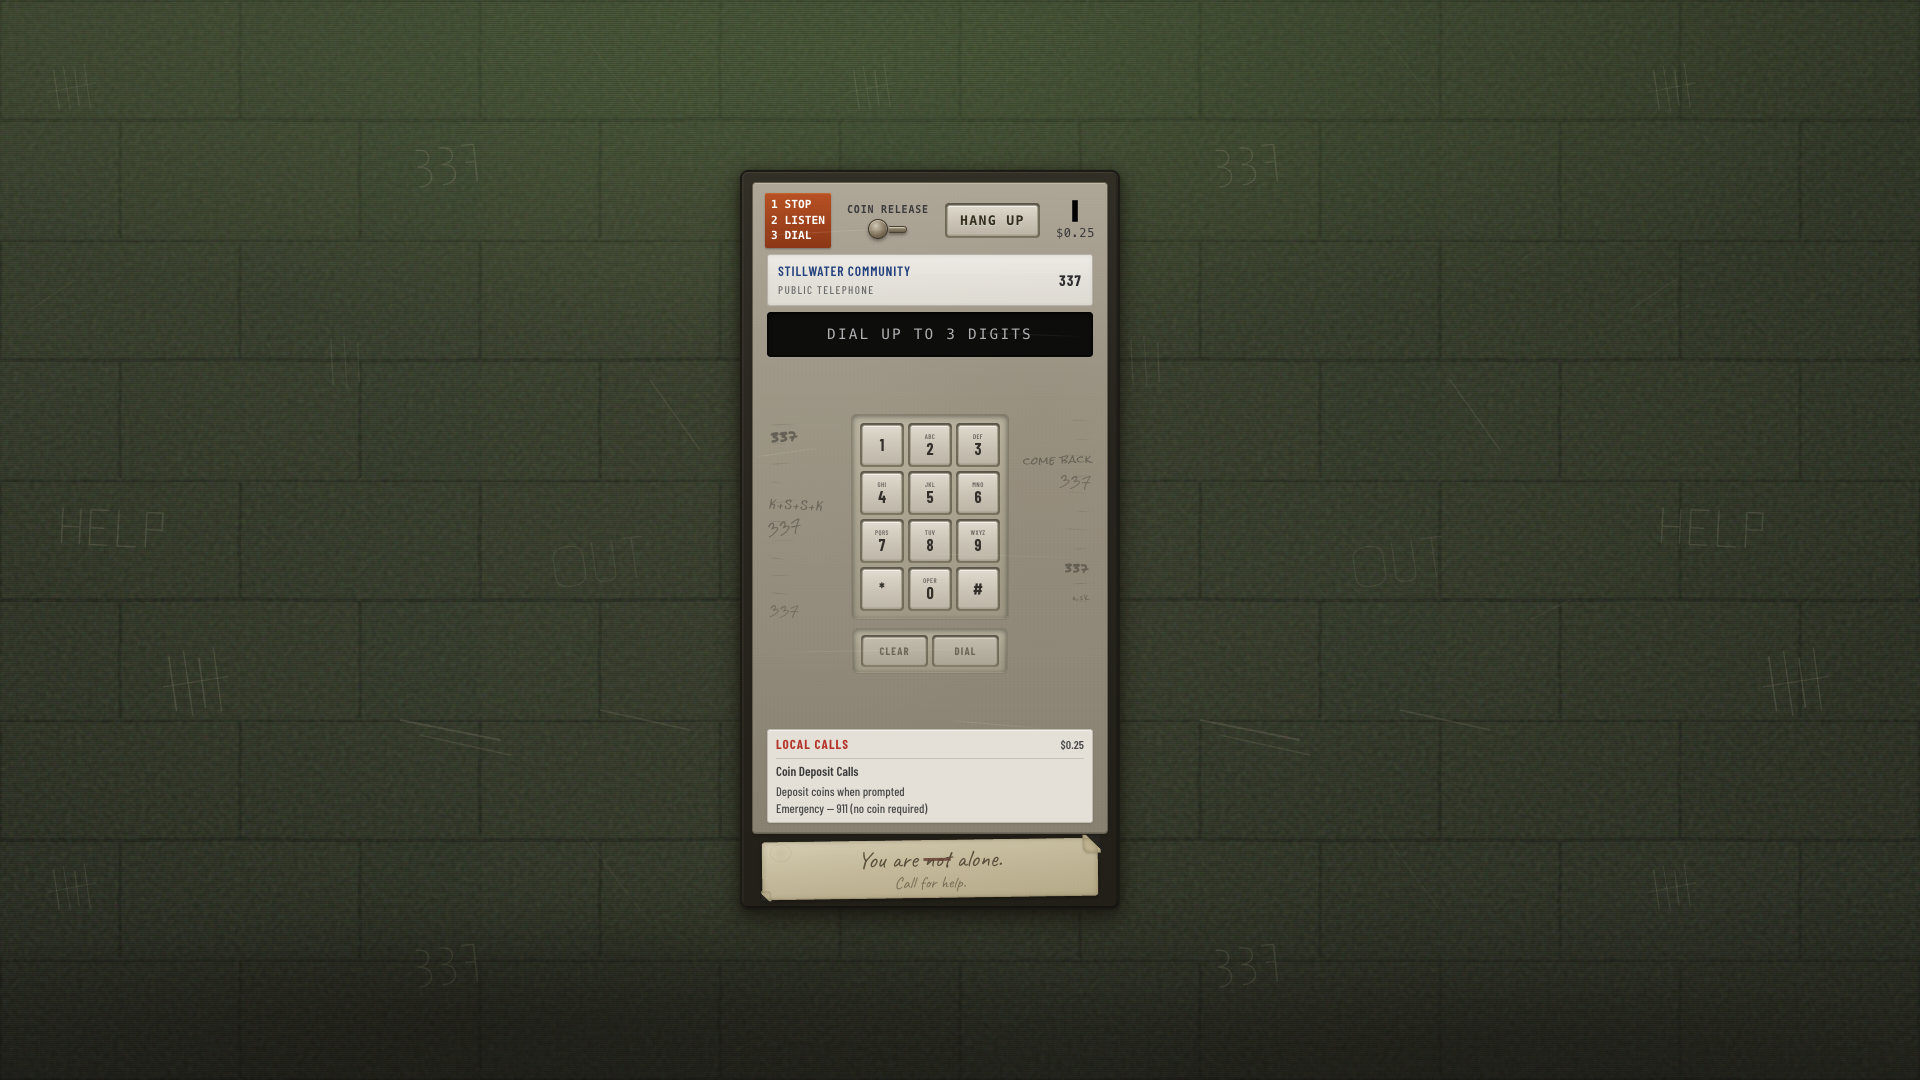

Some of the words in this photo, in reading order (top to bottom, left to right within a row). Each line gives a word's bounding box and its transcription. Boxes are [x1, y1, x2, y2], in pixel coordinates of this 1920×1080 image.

[415, 144, 479, 188] 337
[1215, 144, 1279, 188] 337
[771, 199, 778, 209] 1
[784, 199, 812, 209] STOP
[847, 204, 874, 214] COIN
[880, 204, 929, 214] RELEASE
[770, 215, 778, 225] 2
[785, 215, 825, 225] LISTEN
[960, 214, 996, 226] HANG
[1006, 214, 1024, 226] UP
[771, 230, 778, 240] 3
[784, 230, 812, 240] DIAL
[1056, 227, 1095, 240] $0.25
[777, 265, 844, 277] STILLWATER
[847, 265, 911, 277] COMMUNITY
[1058, 274, 1082, 287] 337
[778, 285, 813, 295] PUBLIC
[816, 285, 874, 295] TELEPHONE
[827, 327, 869, 340] DIAL
[881, 327, 901, 340] UP
[913, 327, 933, 340] TO
[946, 327, 955, 340] 3
[968, 327, 1031, 340] DIGITS
[770, 431, 798, 443] 337
[879, 438, 885, 452] 1
[926, 442, 934, 456] 2
[974, 442, 982, 456] 3
[1022, 456, 1056, 466] COME
[1058, 455, 1094, 465] BACK
[1059, 474, 1092, 490] 337
[877, 490, 887, 504] 4
[926, 490, 934, 504] 5
[974, 490, 982, 504] 6
[768, 499, 824, 511] K+S+S+K
[60, 507, 165, 548] HELP
[768, 518, 802, 538] 337
[1660, 507, 1765, 548] HELP
[878, 538, 886, 552] 7
[926, 538, 934, 552] 8
[974, 538, 982, 552] 9
[552, 535, 643, 588] OUT
[1064, 563, 1089, 574] 337
[1352, 535, 1443, 588] OUT
[926, 586, 934, 600] 0
[972, 582, 983, 596] #
[769, 604, 799, 619] 337
[879, 646, 909, 656] CLEAR
[954, 646, 976, 656] DIAL
[775, 739, 811, 750] LOCAL
[814, 739, 849, 750] CALLS
[1060, 739, 1085, 751] $0.25
[775, 766, 797, 777] Coin
[798, 765, 834, 780] Deposit
[836, 766, 859, 777] Calls
[776, 786, 809, 799] Deposit
[811, 786, 835, 797] coins
[836, 786, 861, 797] when
[862, 786, 905, 800] prompted
[776, 803, 825, 817] Emergency
[836, 803, 848, 814] 911
[849, 803, 865, 815] (no
[866, 803, 886, 814] coin
[887, 802, 929, 817] required)
[862, 851, 888, 870] You
[893, 857, 920, 868] are
[958, 850, 1003, 867] alone.
[895, 876, 918, 890] Call
[921, 877, 938, 890] for
[942, 876, 967, 892] help.
[415, 944, 479, 988] 337
[1215, 944, 1279, 988] 337
